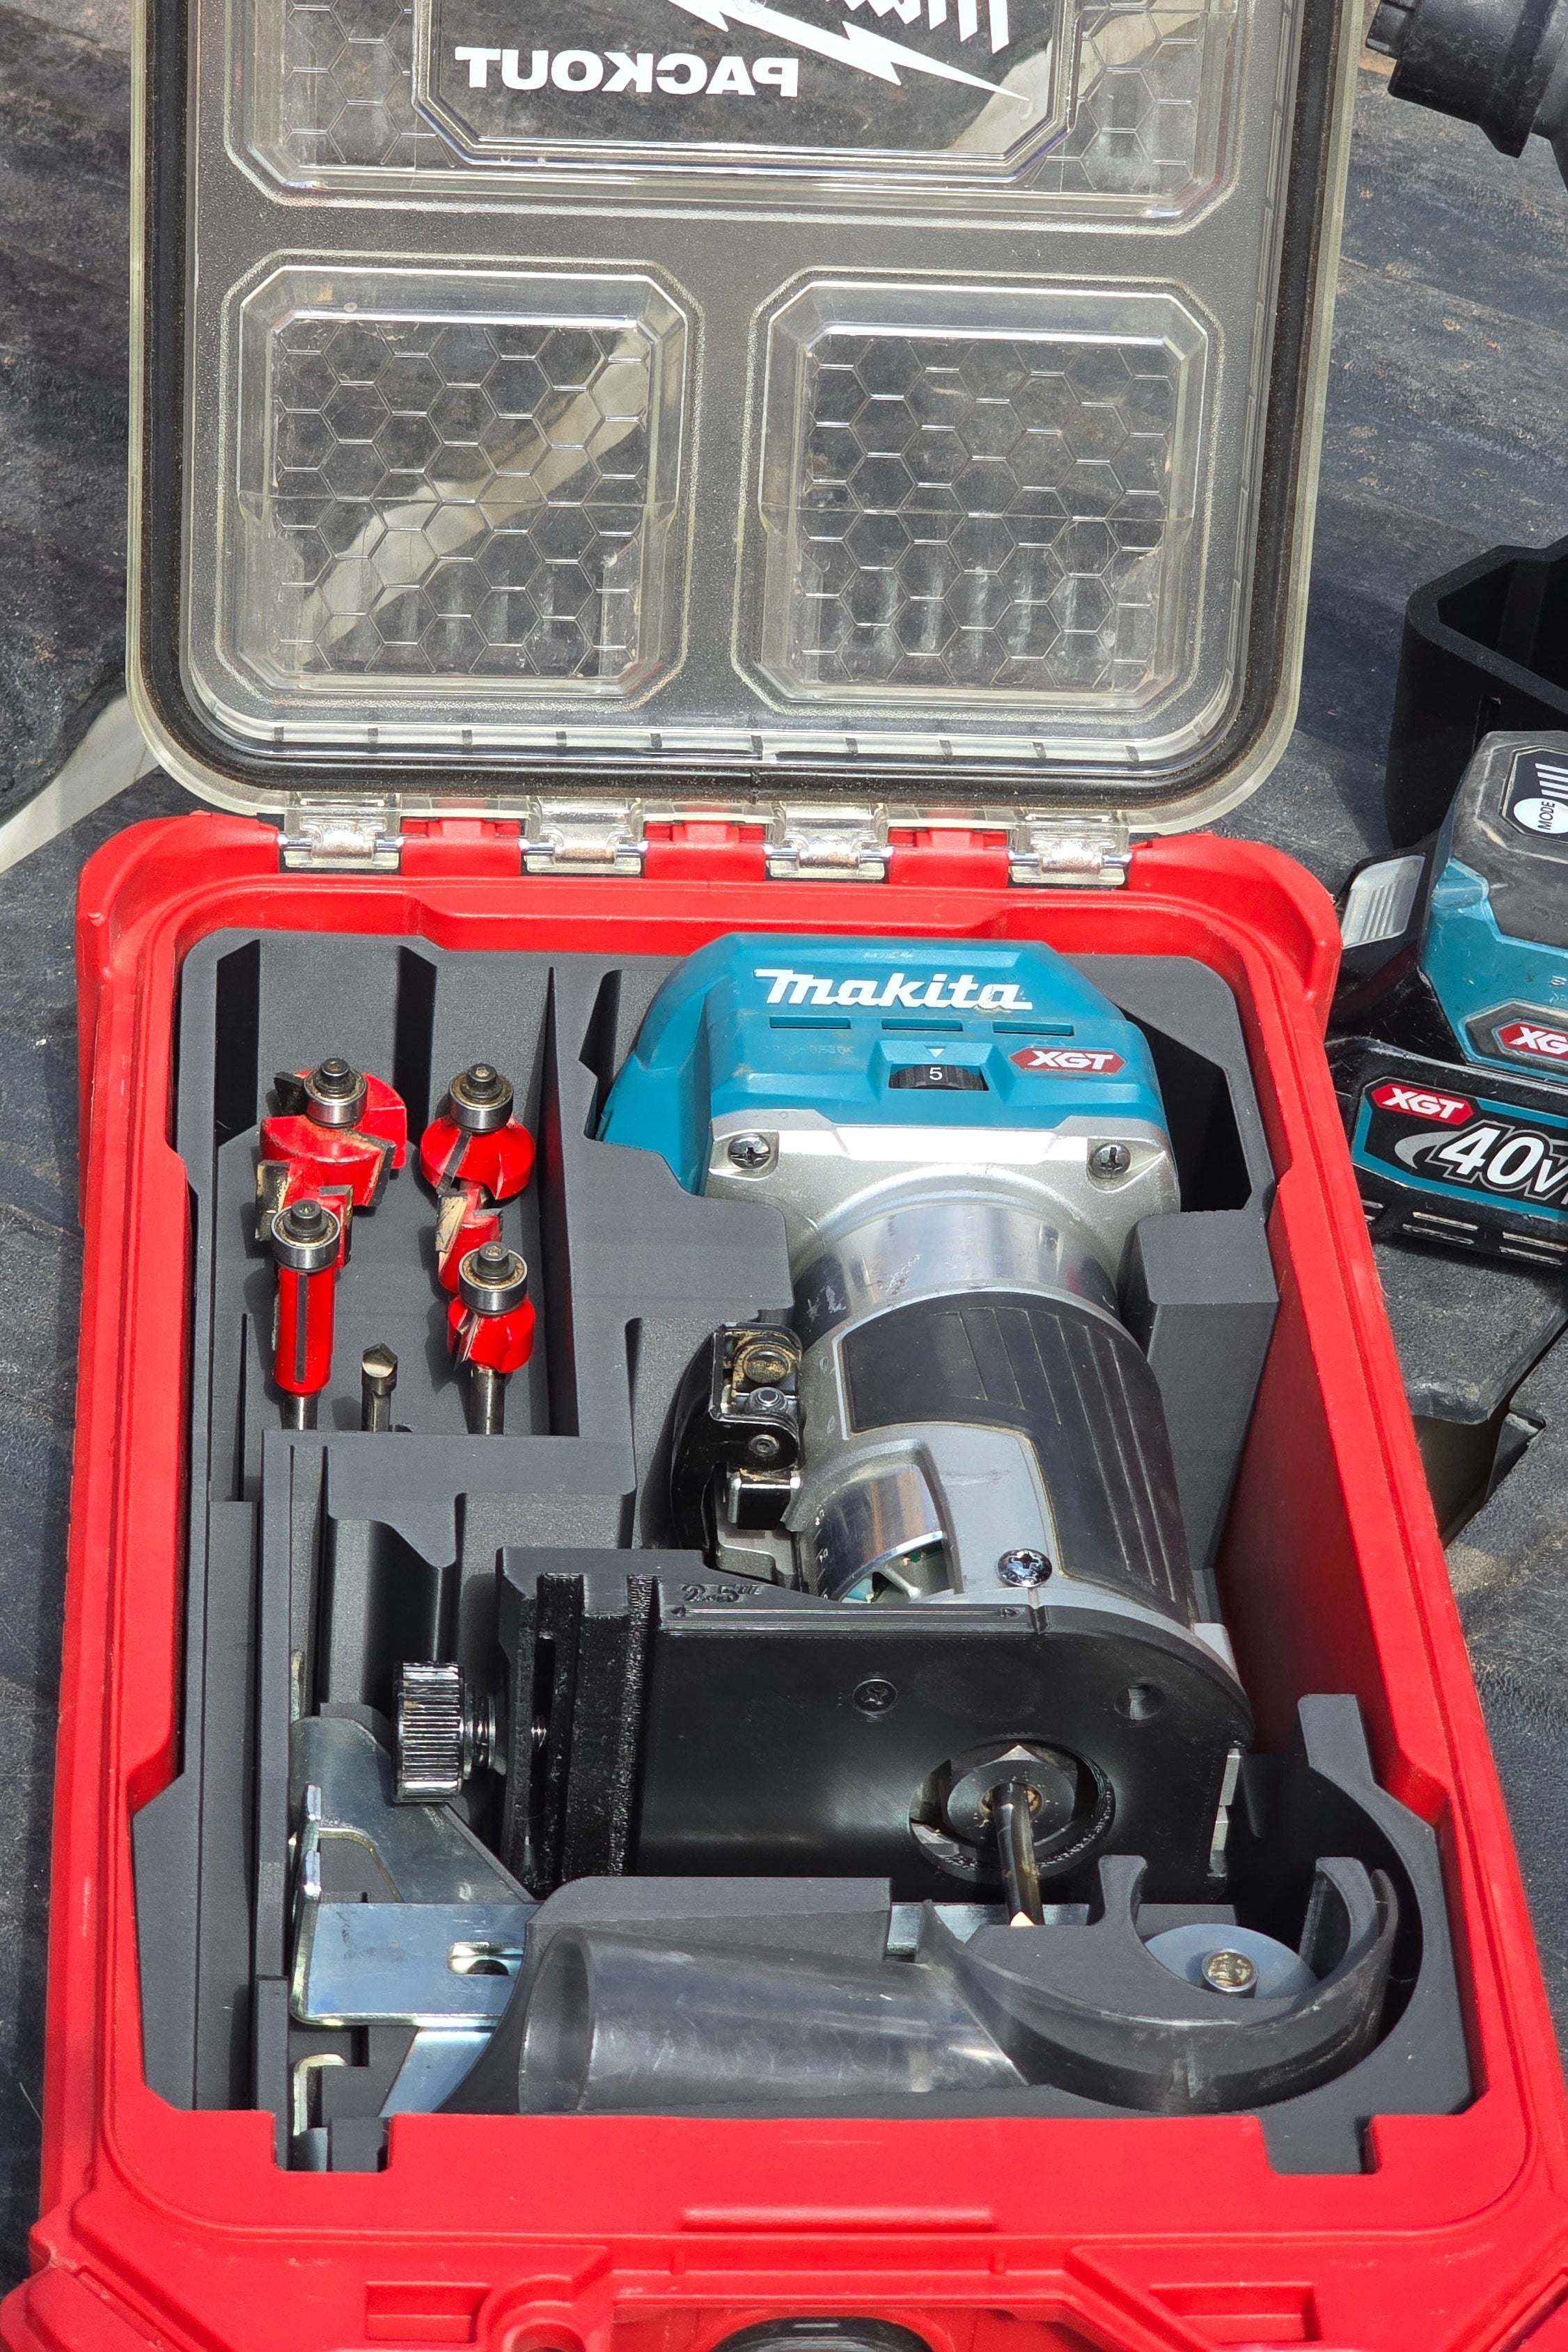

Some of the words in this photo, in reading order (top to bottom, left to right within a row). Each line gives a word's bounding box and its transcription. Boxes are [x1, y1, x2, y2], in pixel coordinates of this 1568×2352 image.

[1537, 801, 1555, 831] MODE
[1027, 1050, 1114, 1070] XGT
[929, 1067, 943, 1081] 5
[1382, 1088, 1465, 1119] XGT
